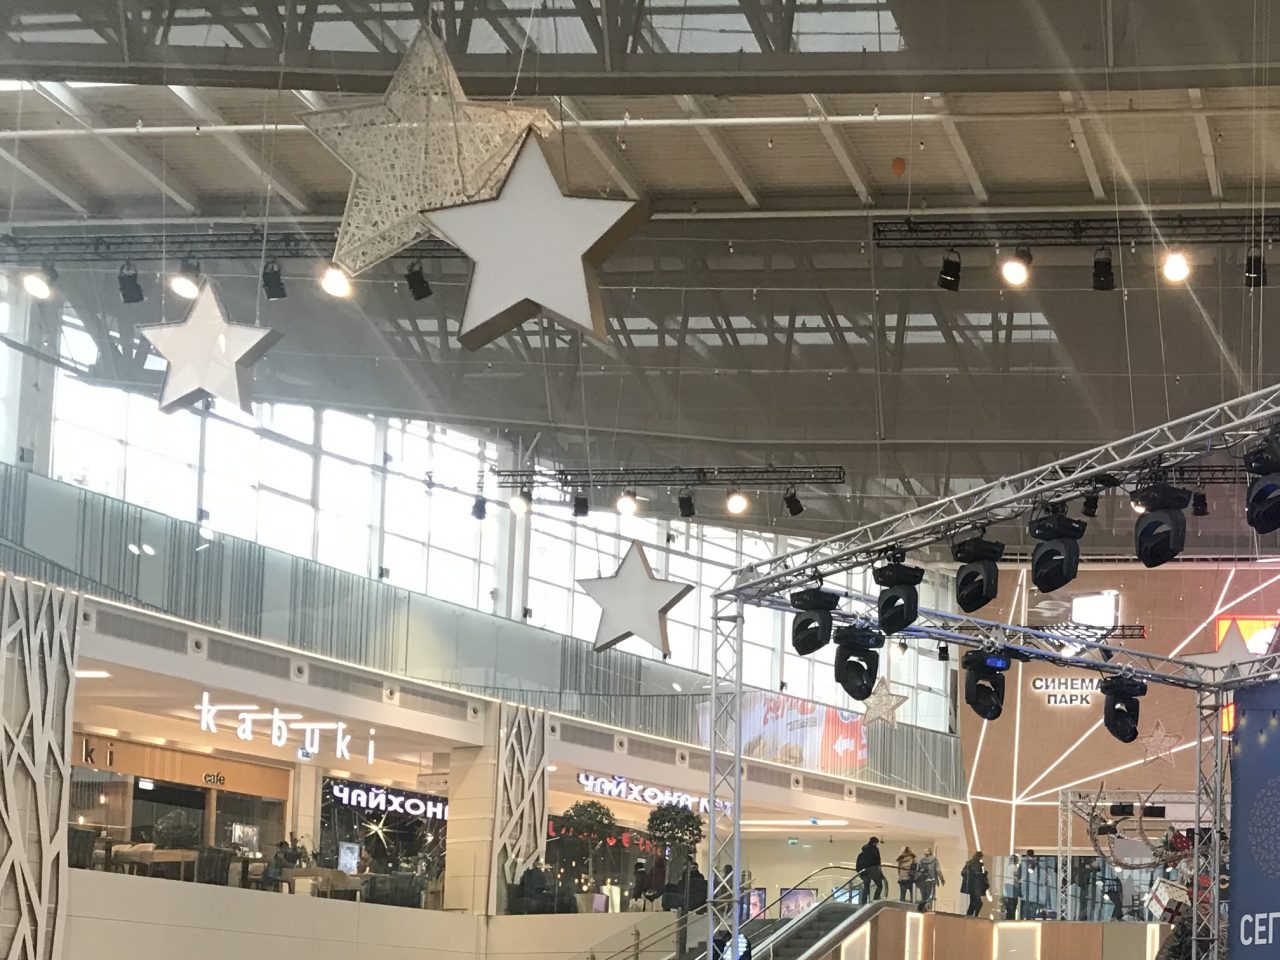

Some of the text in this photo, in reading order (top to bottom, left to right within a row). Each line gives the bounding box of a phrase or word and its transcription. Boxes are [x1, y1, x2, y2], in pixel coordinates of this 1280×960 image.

[1047, 694, 1091, 705] ПАРК
[195, 691, 376, 765] kabuki
[203, 772, 226, 786] cafe
[333, 785, 449, 821] ЧАЙХОН
